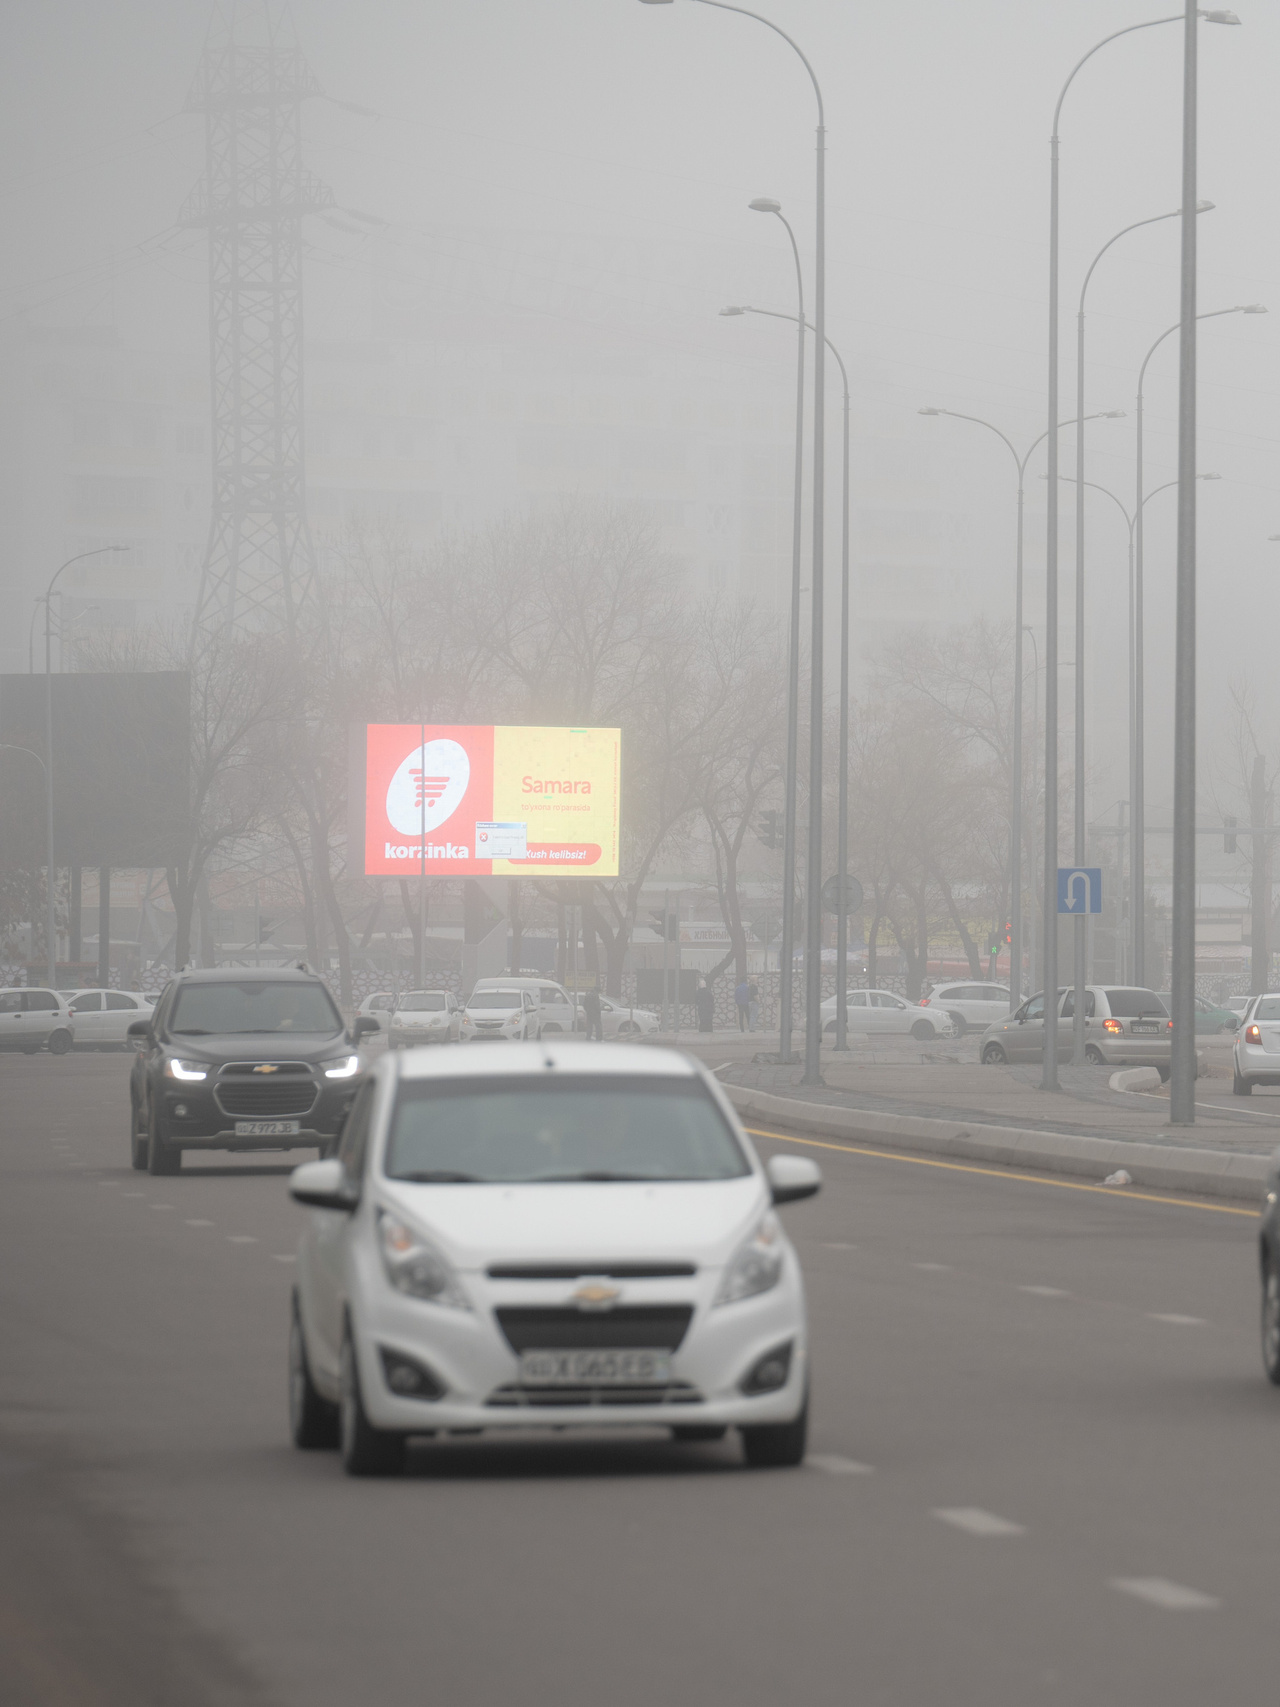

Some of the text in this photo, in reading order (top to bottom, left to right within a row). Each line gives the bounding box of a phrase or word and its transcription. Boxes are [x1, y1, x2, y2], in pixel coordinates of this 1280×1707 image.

[522, 776, 591, 794] Samara
[384, 842, 469, 859] korzinka
[526, 849, 586, 860] Xush kelibsiz!
